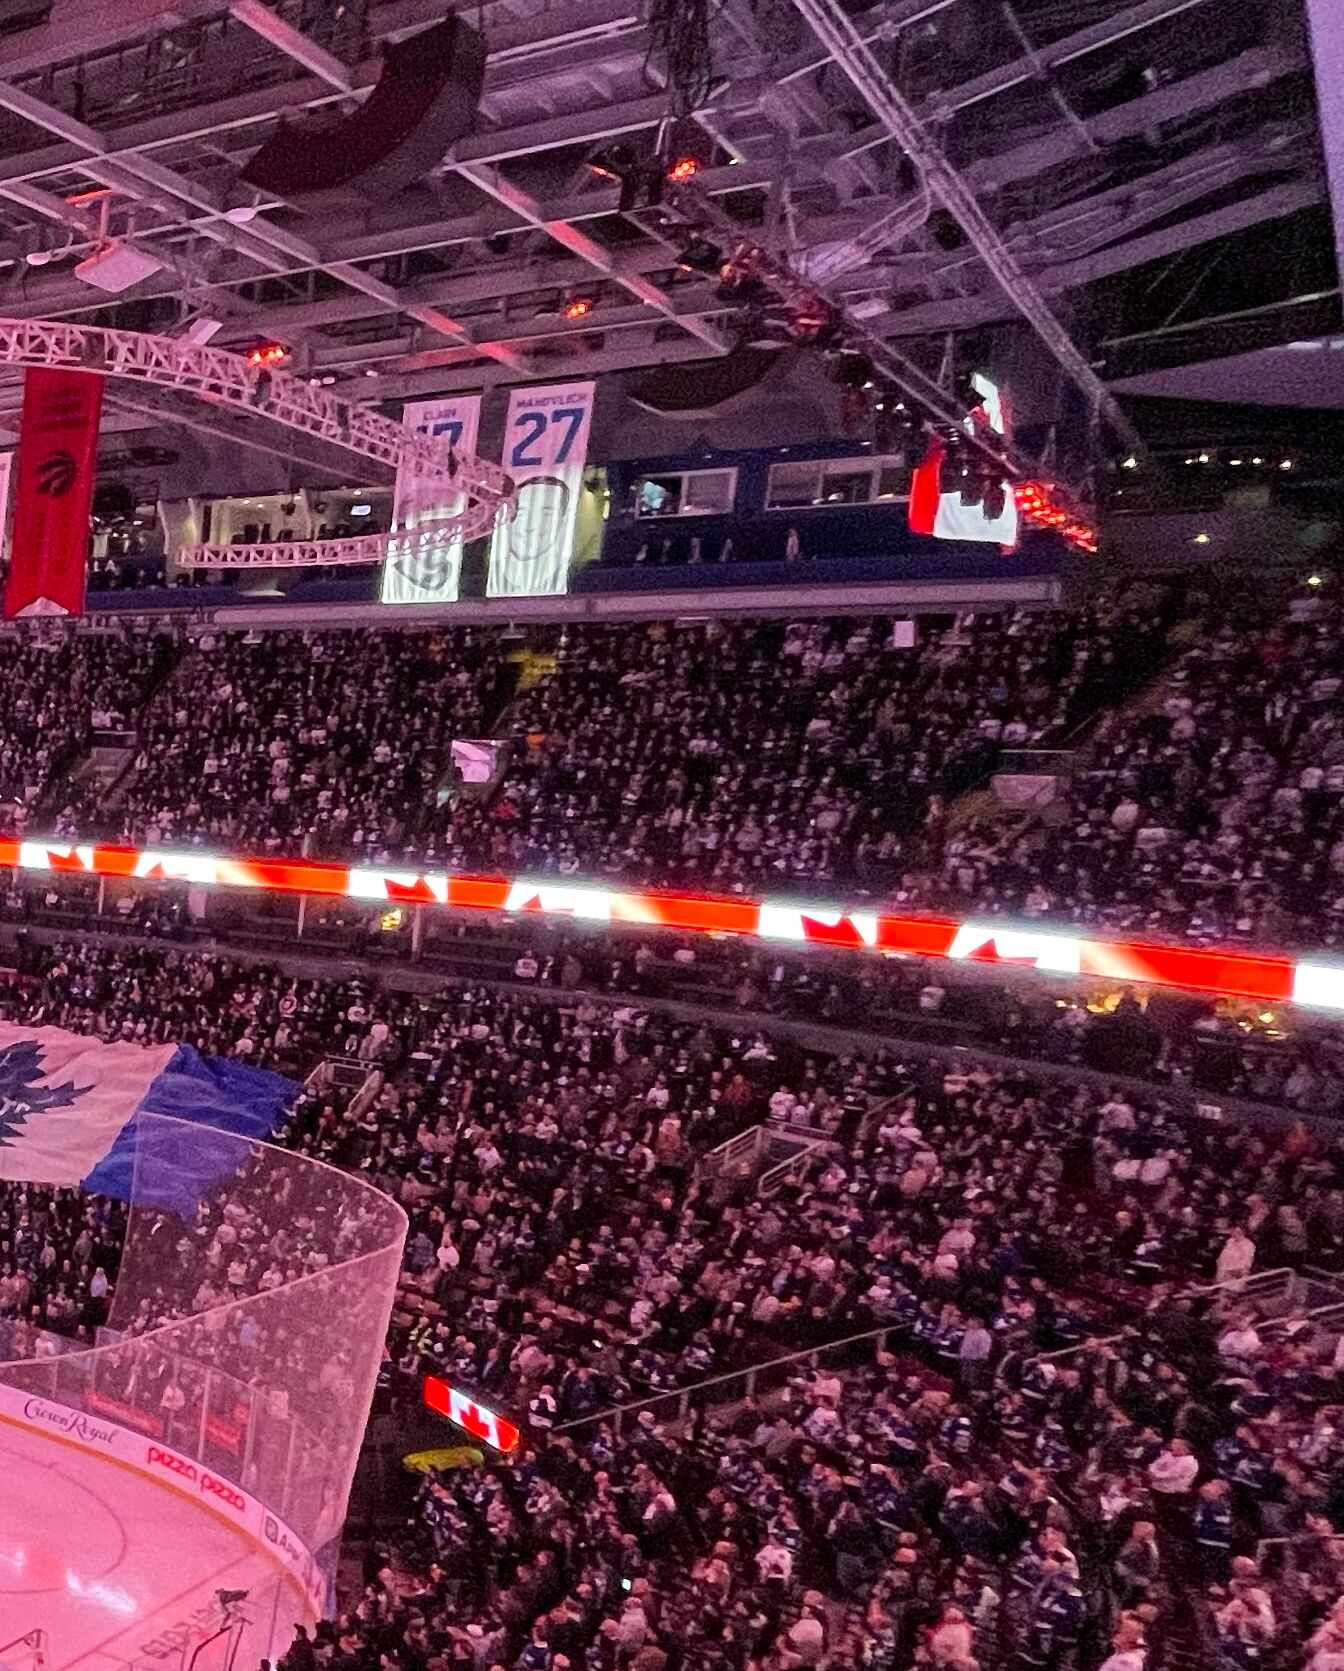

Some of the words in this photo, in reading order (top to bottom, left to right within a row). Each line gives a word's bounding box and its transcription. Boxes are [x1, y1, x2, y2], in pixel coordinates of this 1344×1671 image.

[416, 421, 464, 449] 7
[511, 407, 584, 467] 27
[24, 1397, 72, 1432] Crown
[67, 1411, 120, 1445] Royal
[147, 1446, 198, 1482] pizza
[200, 1473, 246, 1513] pizza
